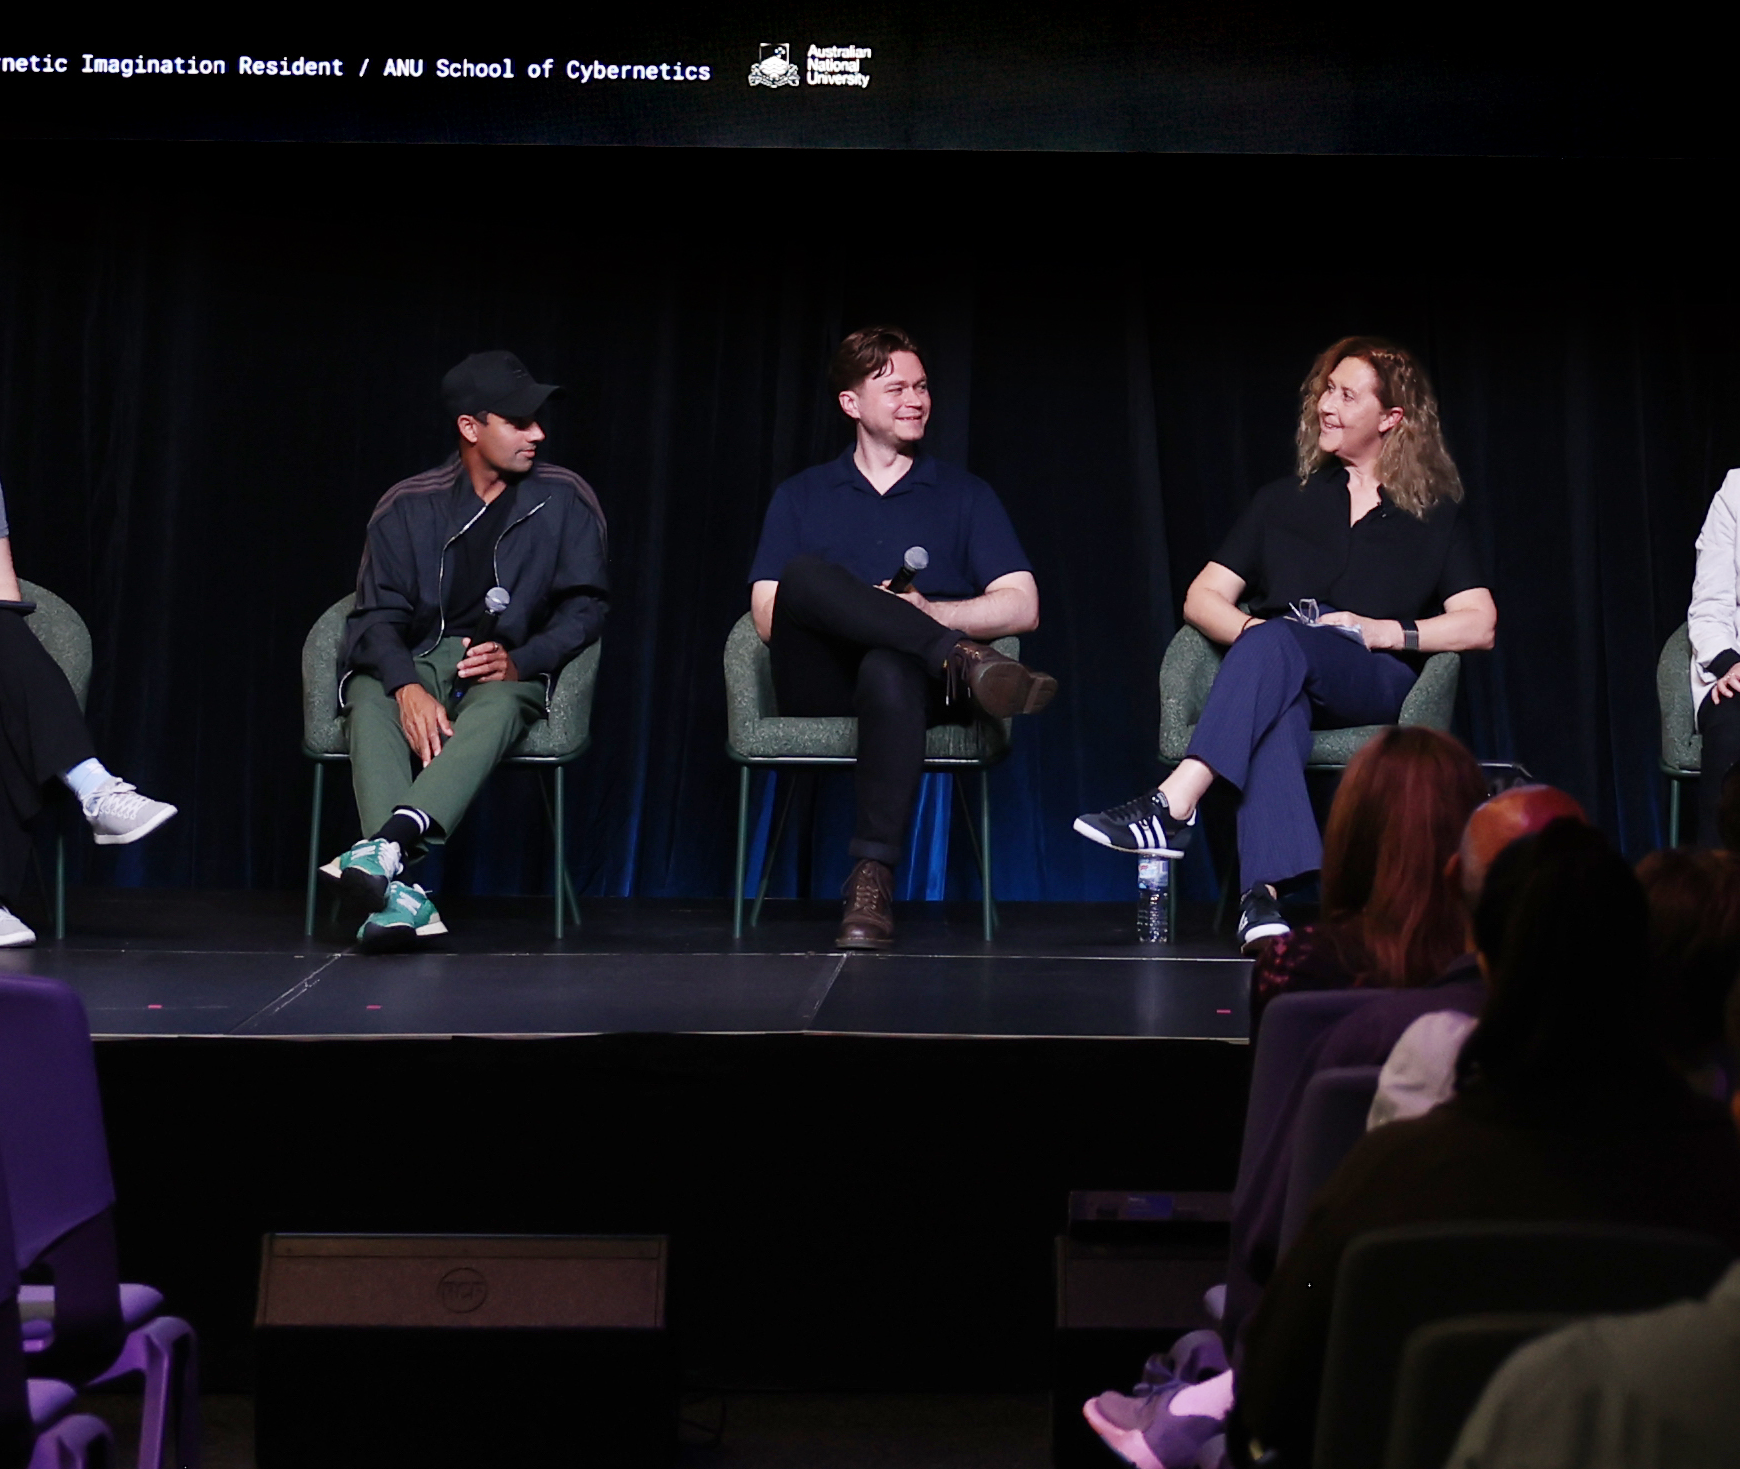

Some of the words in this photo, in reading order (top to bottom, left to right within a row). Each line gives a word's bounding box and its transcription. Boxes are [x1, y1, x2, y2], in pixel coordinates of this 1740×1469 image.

[806, 44, 872, 58] Australian
[81, 53, 226, 78] Imagination
[238, 55, 344, 77] Resident
[382, 58, 424, 78] ANU
[436, 57, 515, 79] School
[527, 58, 554, 79] of
[566, 59, 711, 84] Cybernetics
[806, 58, 860, 73] National
[806, 71, 871, 89] University
